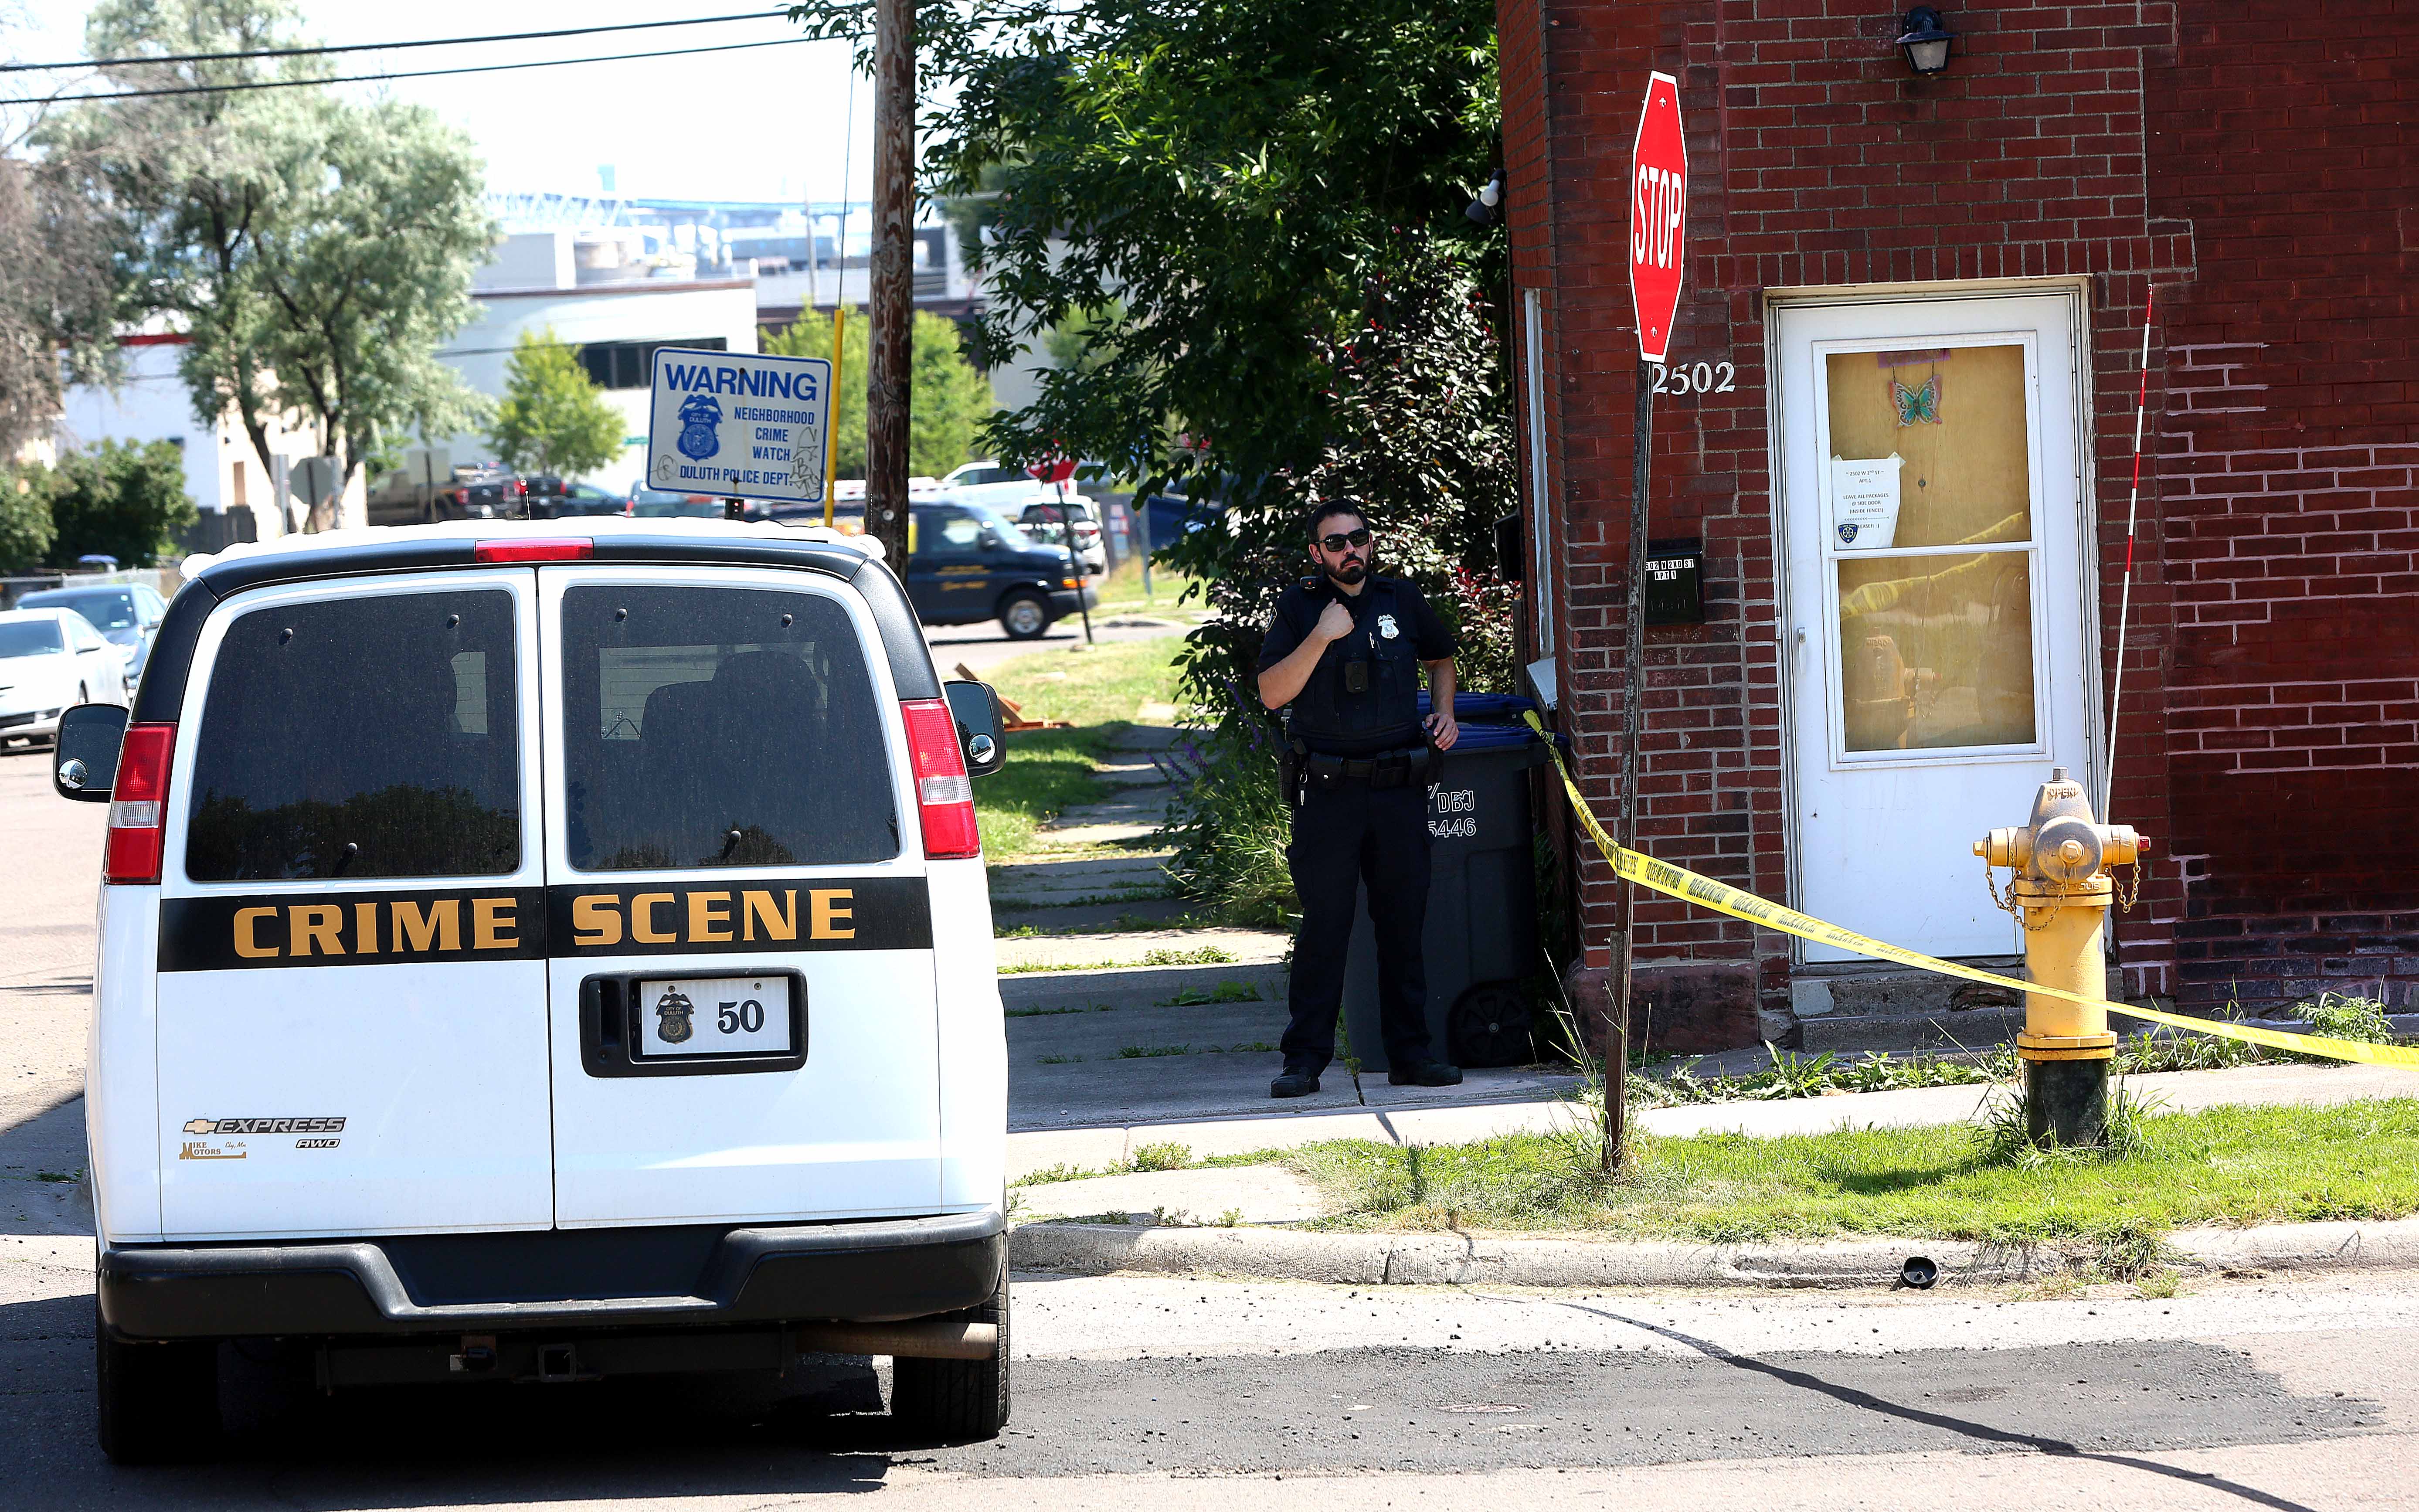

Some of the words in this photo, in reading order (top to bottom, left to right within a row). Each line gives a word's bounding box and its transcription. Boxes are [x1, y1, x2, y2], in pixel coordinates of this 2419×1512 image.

[1635, 163, 1683, 269] STOP
[665, 363, 818, 401] WARNING
[1652, 361, 1736, 395] 2502
[734, 406, 815, 425] NEIGHBORHOOD
[755, 426, 789, 442] CRIME
[752, 445, 791, 461] WATCH
[680, 465, 719, 481] DULUTH
[723, 468, 760, 483] POLICE
[763, 472, 793, 486] DEPT.
[1655, 571, 1668, 580] APT
[1437, 789, 1475, 813] DBJ
[2049, 788, 2076, 797] OPEN
[1427, 817, 1477, 838] 5446
[233, 897, 520, 958] CRIME
[572, 888, 856, 946] SCENE
[717, 999, 764, 1034] 50
[216, 1118, 346, 1134] EXPRESS
[225, 1142, 236, 1150] Ely,
[297, 1139, 340, 1148] AWD
